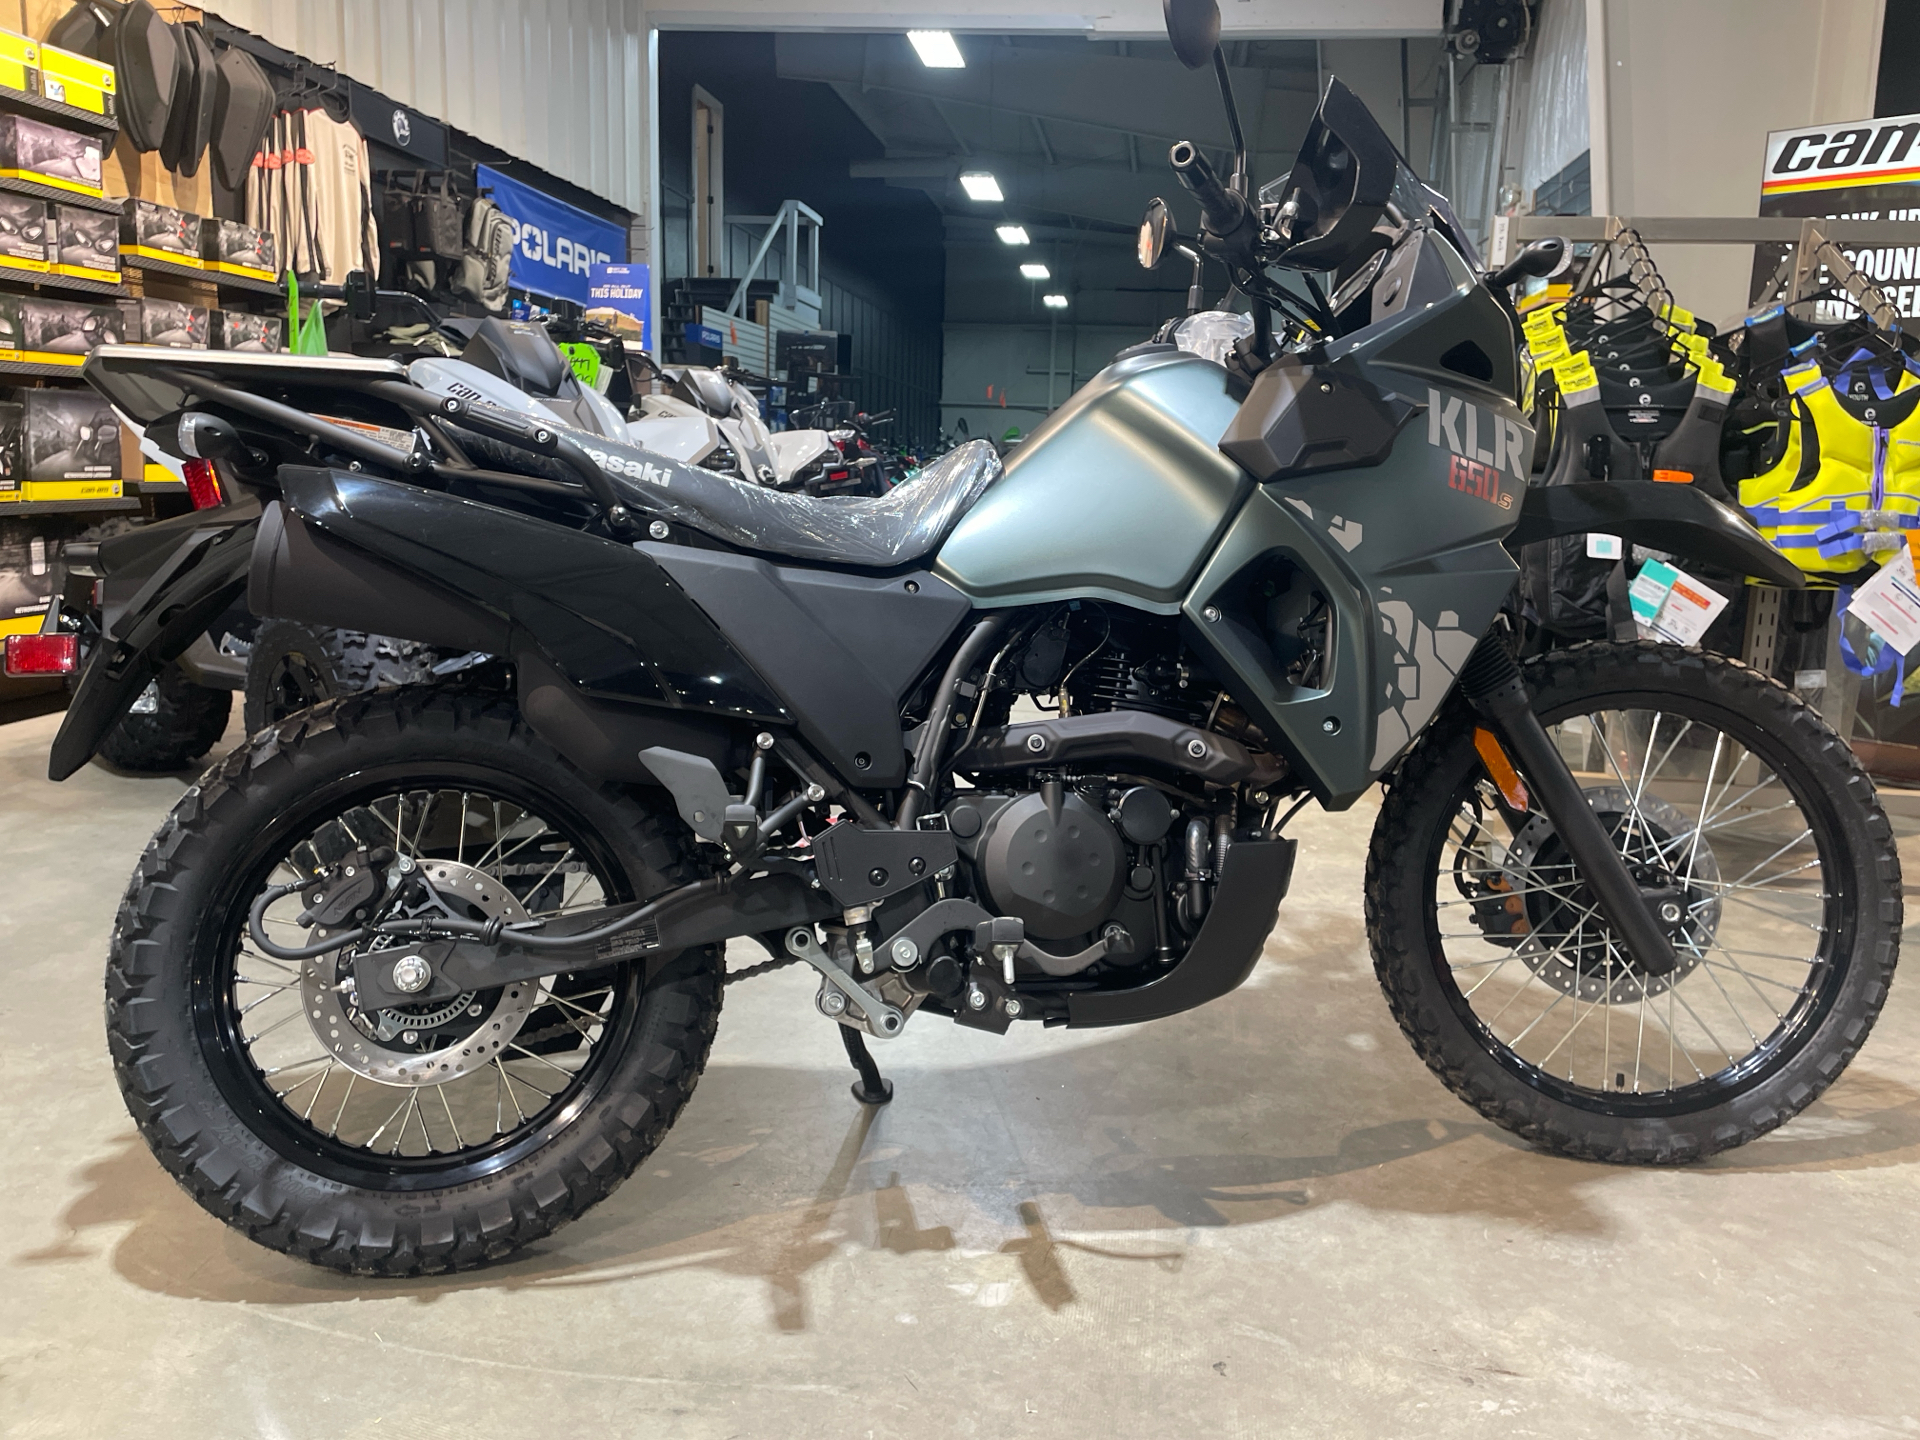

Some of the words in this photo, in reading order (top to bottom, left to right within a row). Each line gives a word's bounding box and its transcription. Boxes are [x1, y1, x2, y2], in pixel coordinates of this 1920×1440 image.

[591, 288, 609, 298] THIS
[610, 288, 643, 299] HOLIDAY
[1428, 387, 1525, 481] KLR
[584, 448, 672, 488] asaki
[1448, 454, 1499, 505] 650
